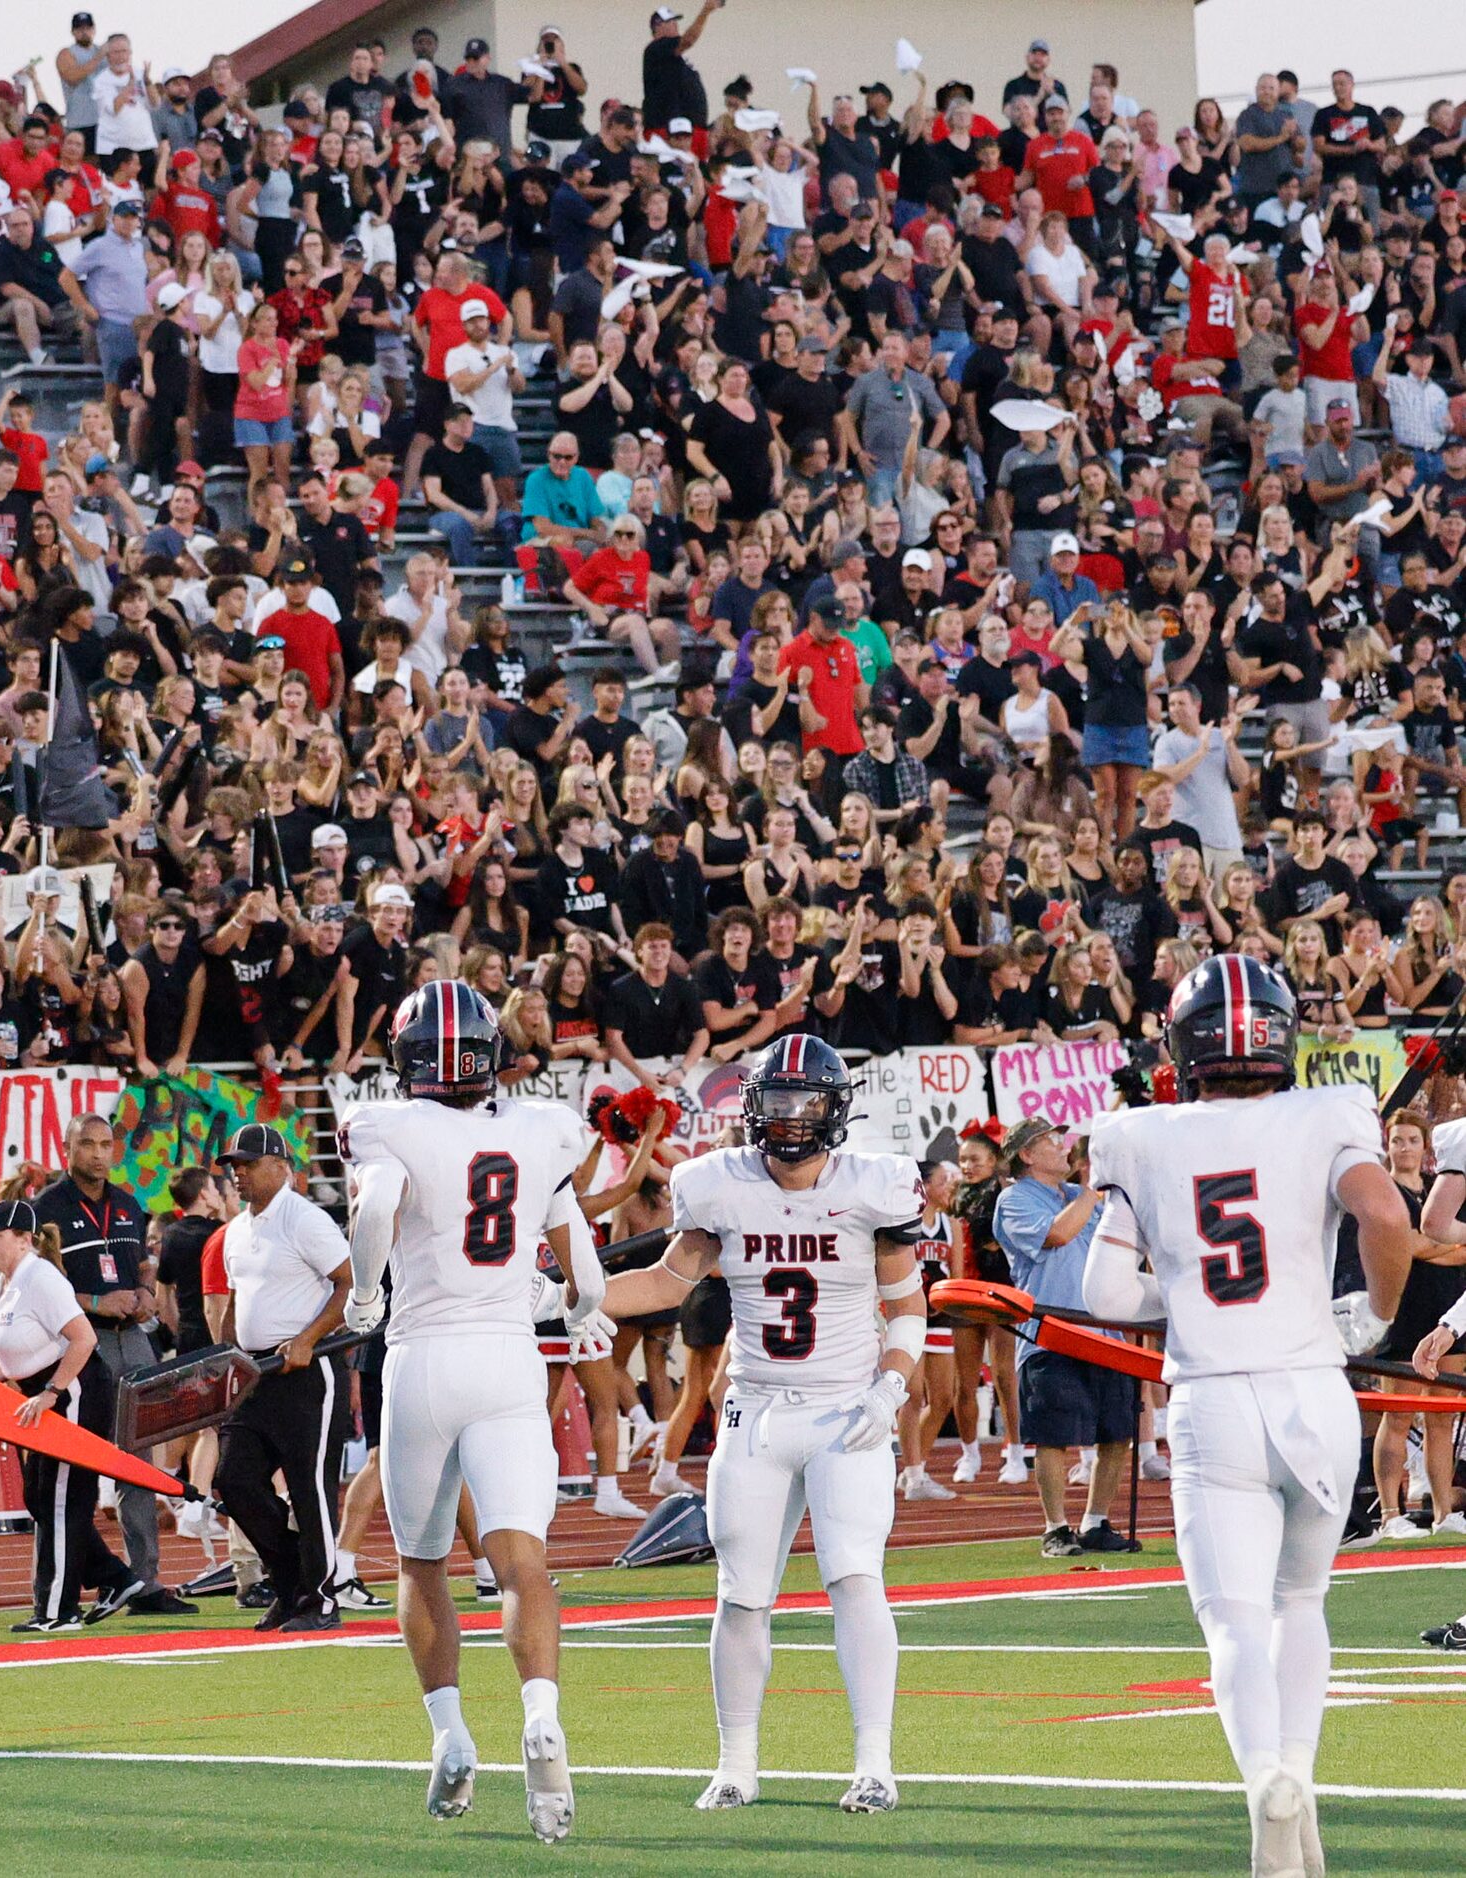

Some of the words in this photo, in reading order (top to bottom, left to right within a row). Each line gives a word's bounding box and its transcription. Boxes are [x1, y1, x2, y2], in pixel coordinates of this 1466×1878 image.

[1252, 1018, 1269, 1048] 5
[460, 1052, 476, 1076] 8
[919, 1053, 971, 1095] RED
[999, 1044, 1044, 1088] MY
[1018, 1080, 1107, 1126] PONY
[462, 1151, 519, 1267] 8
[743, 1233, 839, 1263] PRIDE
[1192, 1168, 1269, 1306] 5
[762, 1267, 818, 1362] 3
